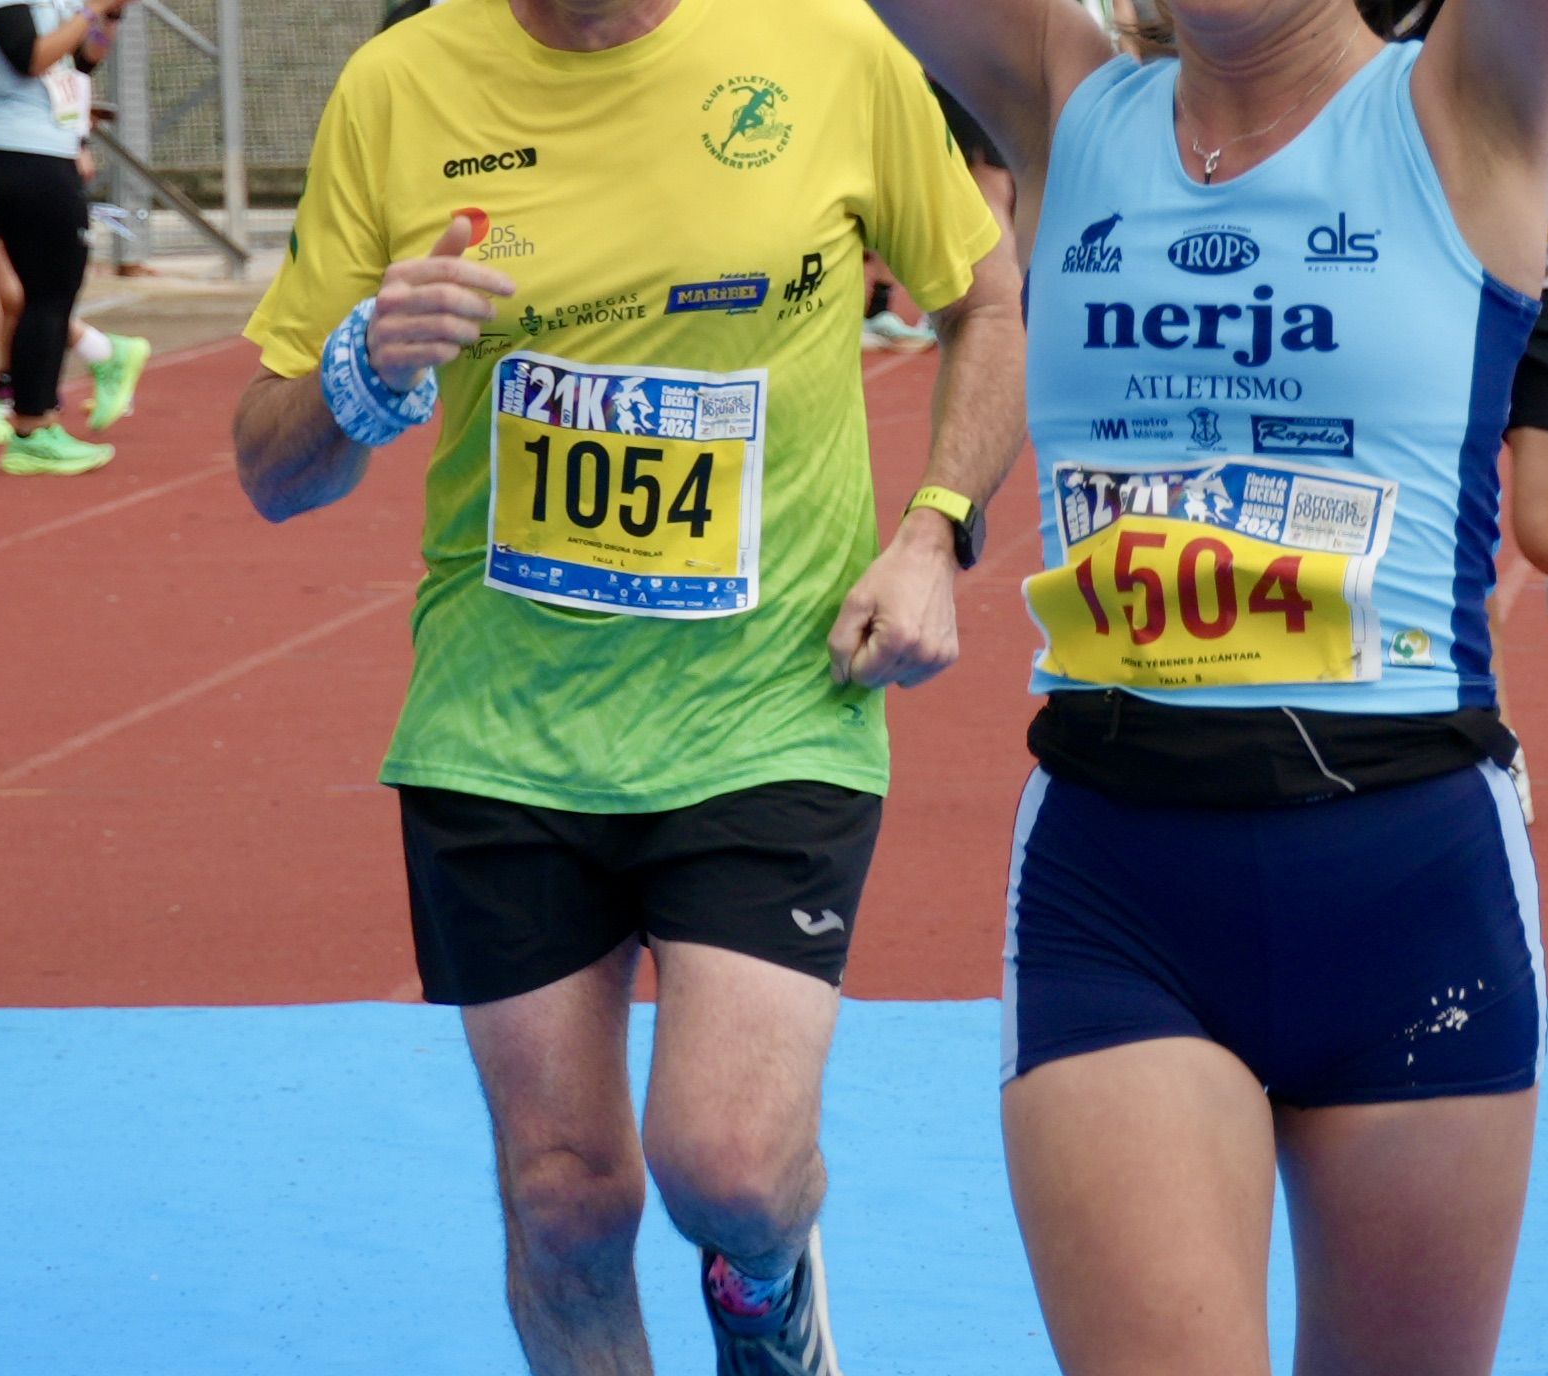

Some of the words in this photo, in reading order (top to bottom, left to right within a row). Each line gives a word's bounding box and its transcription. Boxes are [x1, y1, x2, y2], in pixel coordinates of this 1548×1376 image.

[701, 84, 725, 112] CLUB
[728, 75, 789, 102] ATLETISMO
[701, 133, 743, 169] RUNNERS
[747, 153, 777, 169] PURA
[776, 124, 793, 152] CEPA
[443, 152, 516, 178] emec
[491, 225, 516, 244] DS
[478, 238, 535, 261] Smith
[1064, 246, 1123, 262] CUEVA
[1172, 233, 1256, 269] TROPS
[556, 293, 639, 317] BODEGAS
[777, 298, 824, 321] RIADA
[548, 319, 568, 332] EL
[576, 305, 647, 326] MONTE
[1083, 284, 1339, 369] nerja
[525, 365, 610, 431] 21K
[1124, 374, 1302, 402] ATLETISMO
[658, 417, 693, 438] 2026
[1260, 423, 1345, 446] Rogelio
[524, 435, 714, 539] 1054
[1243, 484, 1286, 505] LUCENA
[1293, 502, 1368, 527] populares
[1296, 492, 1358, 513] carreras
[1234, 515, 1280, 542] 2026
[1075, 529, 1313, 647] 1504
